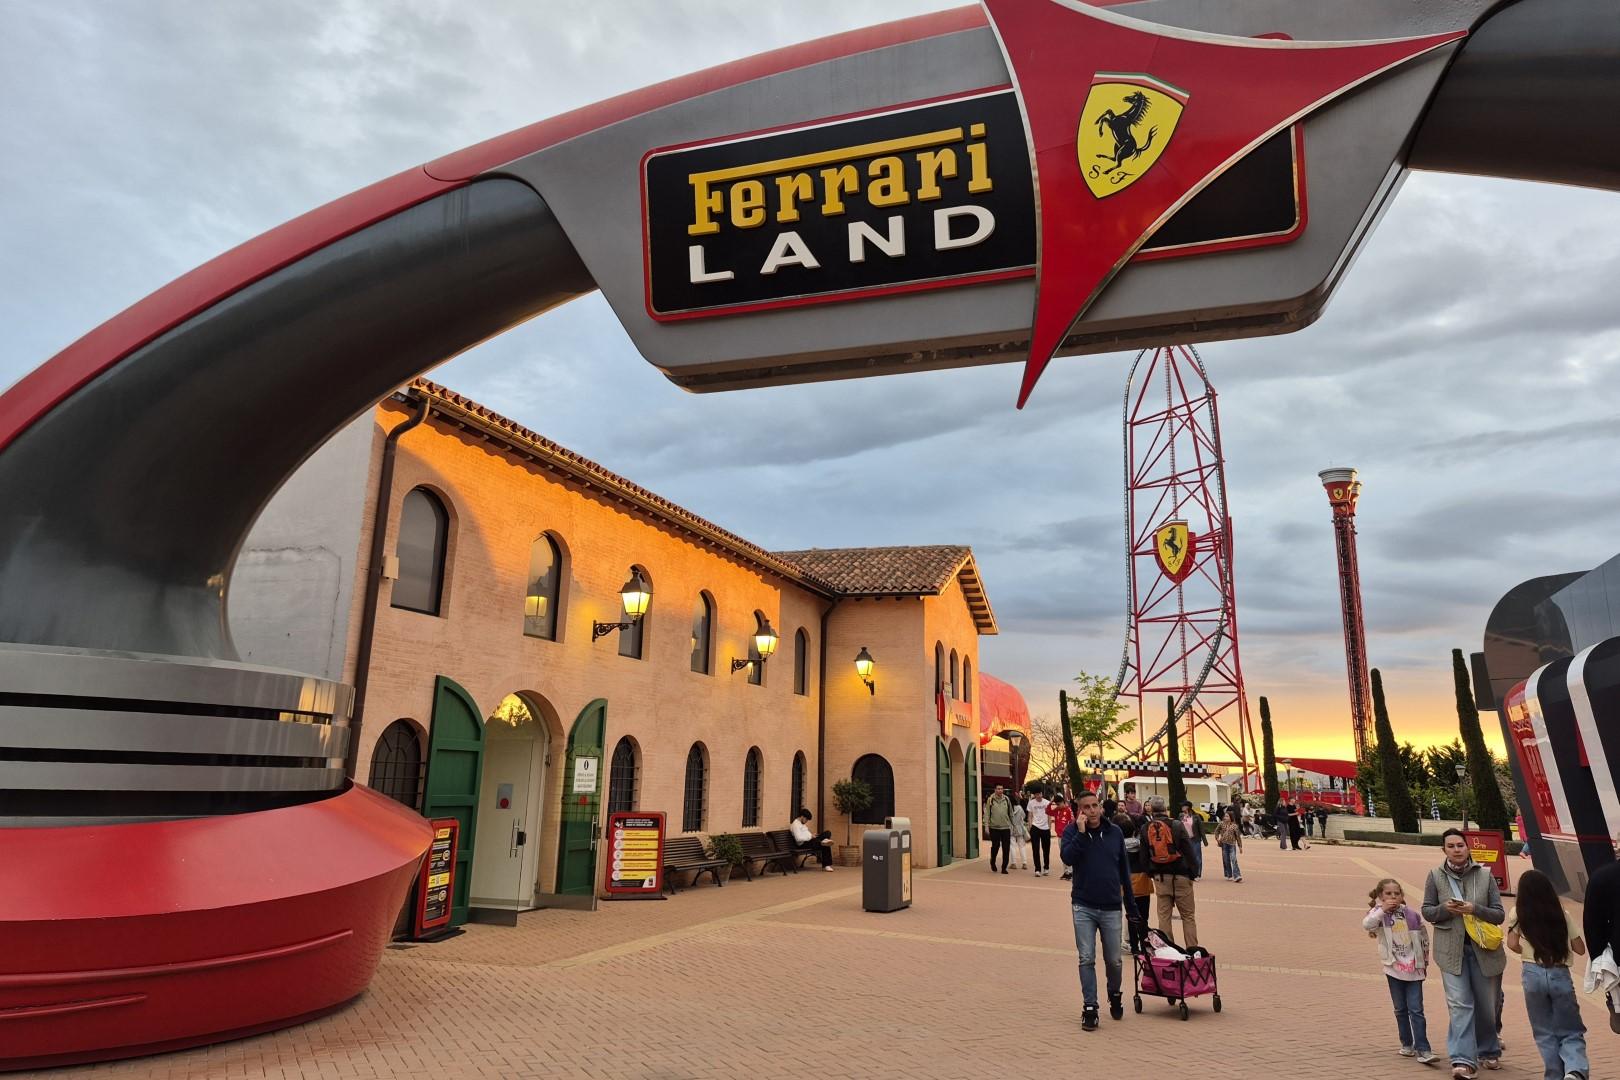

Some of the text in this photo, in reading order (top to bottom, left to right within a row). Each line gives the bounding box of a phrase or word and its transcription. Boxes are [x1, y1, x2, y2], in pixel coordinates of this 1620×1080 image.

[688, 122, 993, 236] Ferrari
[1088, 164, 1101, 179] S
[688, 204, 996, 284] LAND
